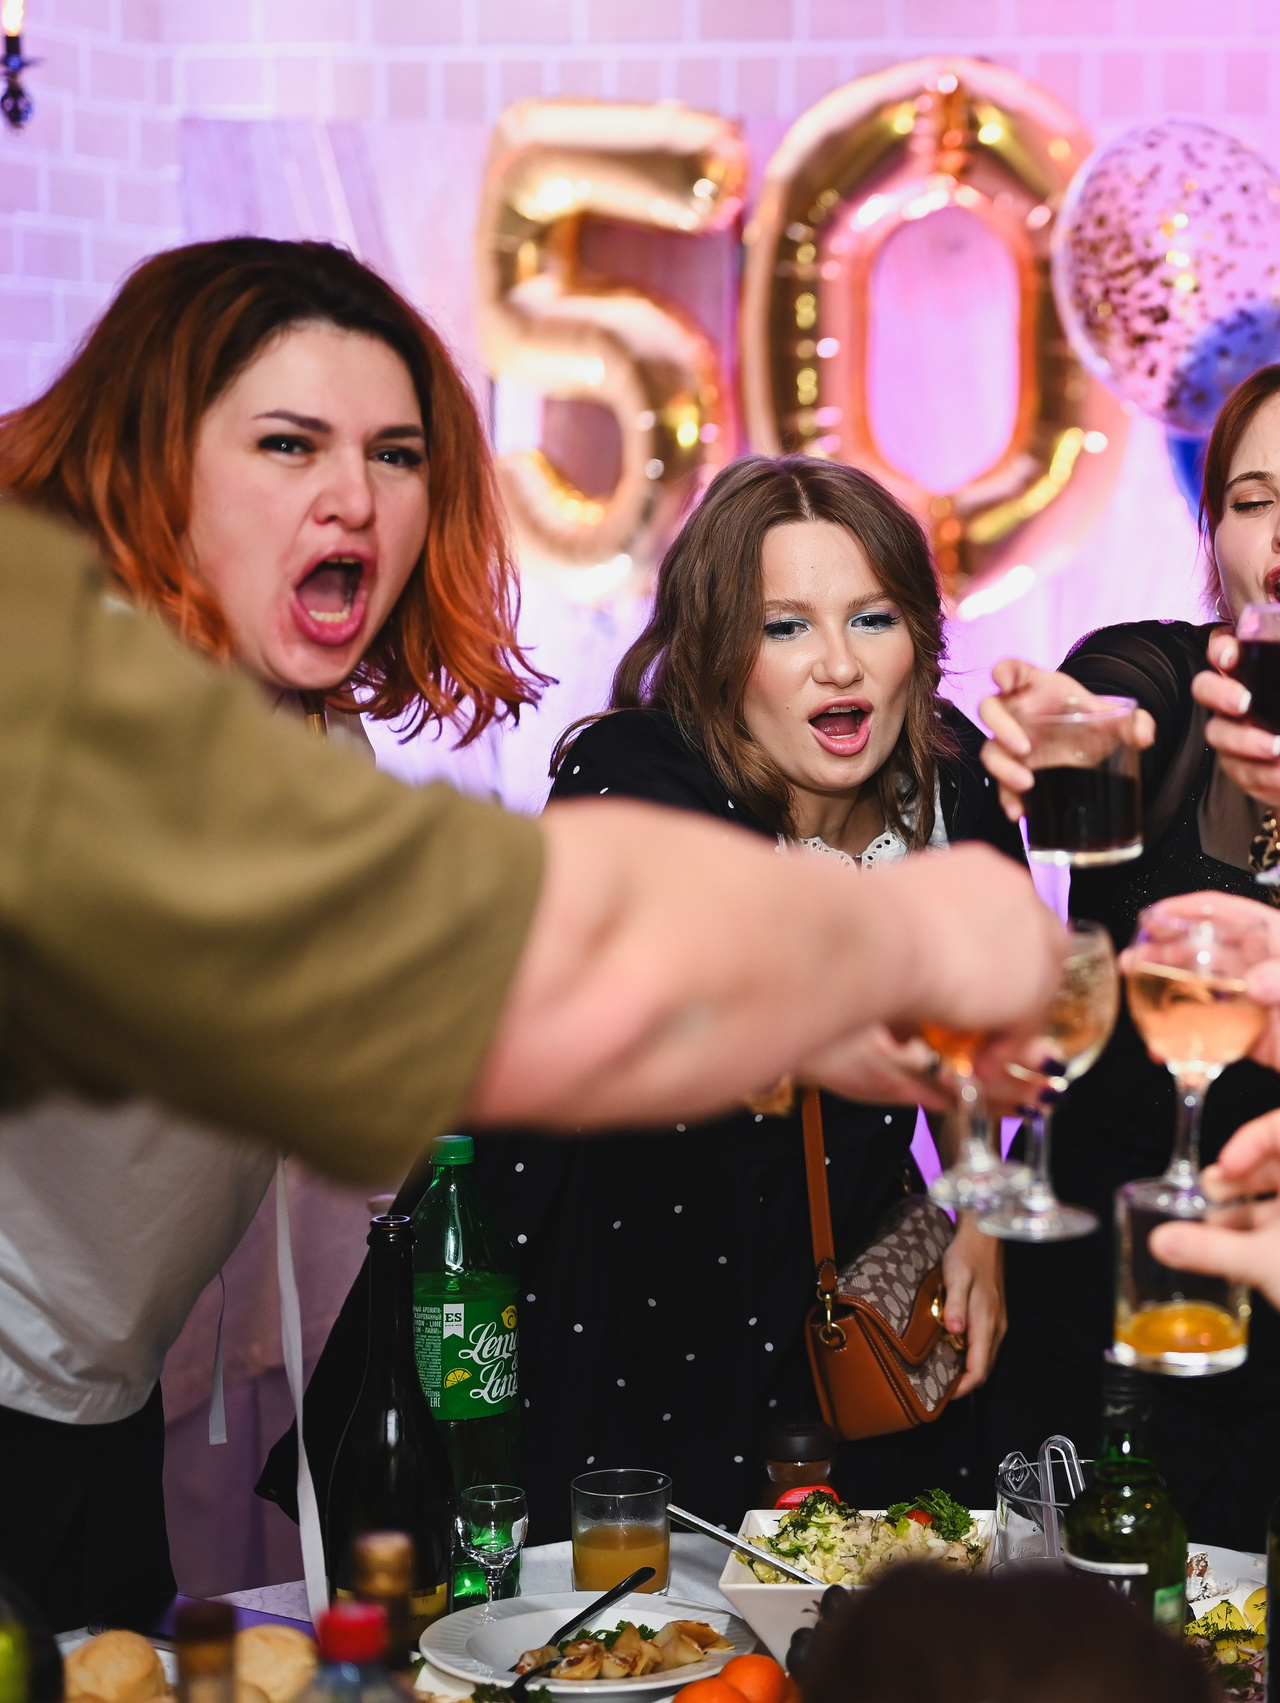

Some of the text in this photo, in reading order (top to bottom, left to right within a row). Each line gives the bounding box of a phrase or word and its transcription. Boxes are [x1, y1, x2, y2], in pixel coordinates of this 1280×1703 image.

[474, 56, 1132, 618] 50
[445, 1312, 462, 1323] ES
[469, 1360, 518, 1404] Lim
[430, 1396, 441, 1408] EAC
